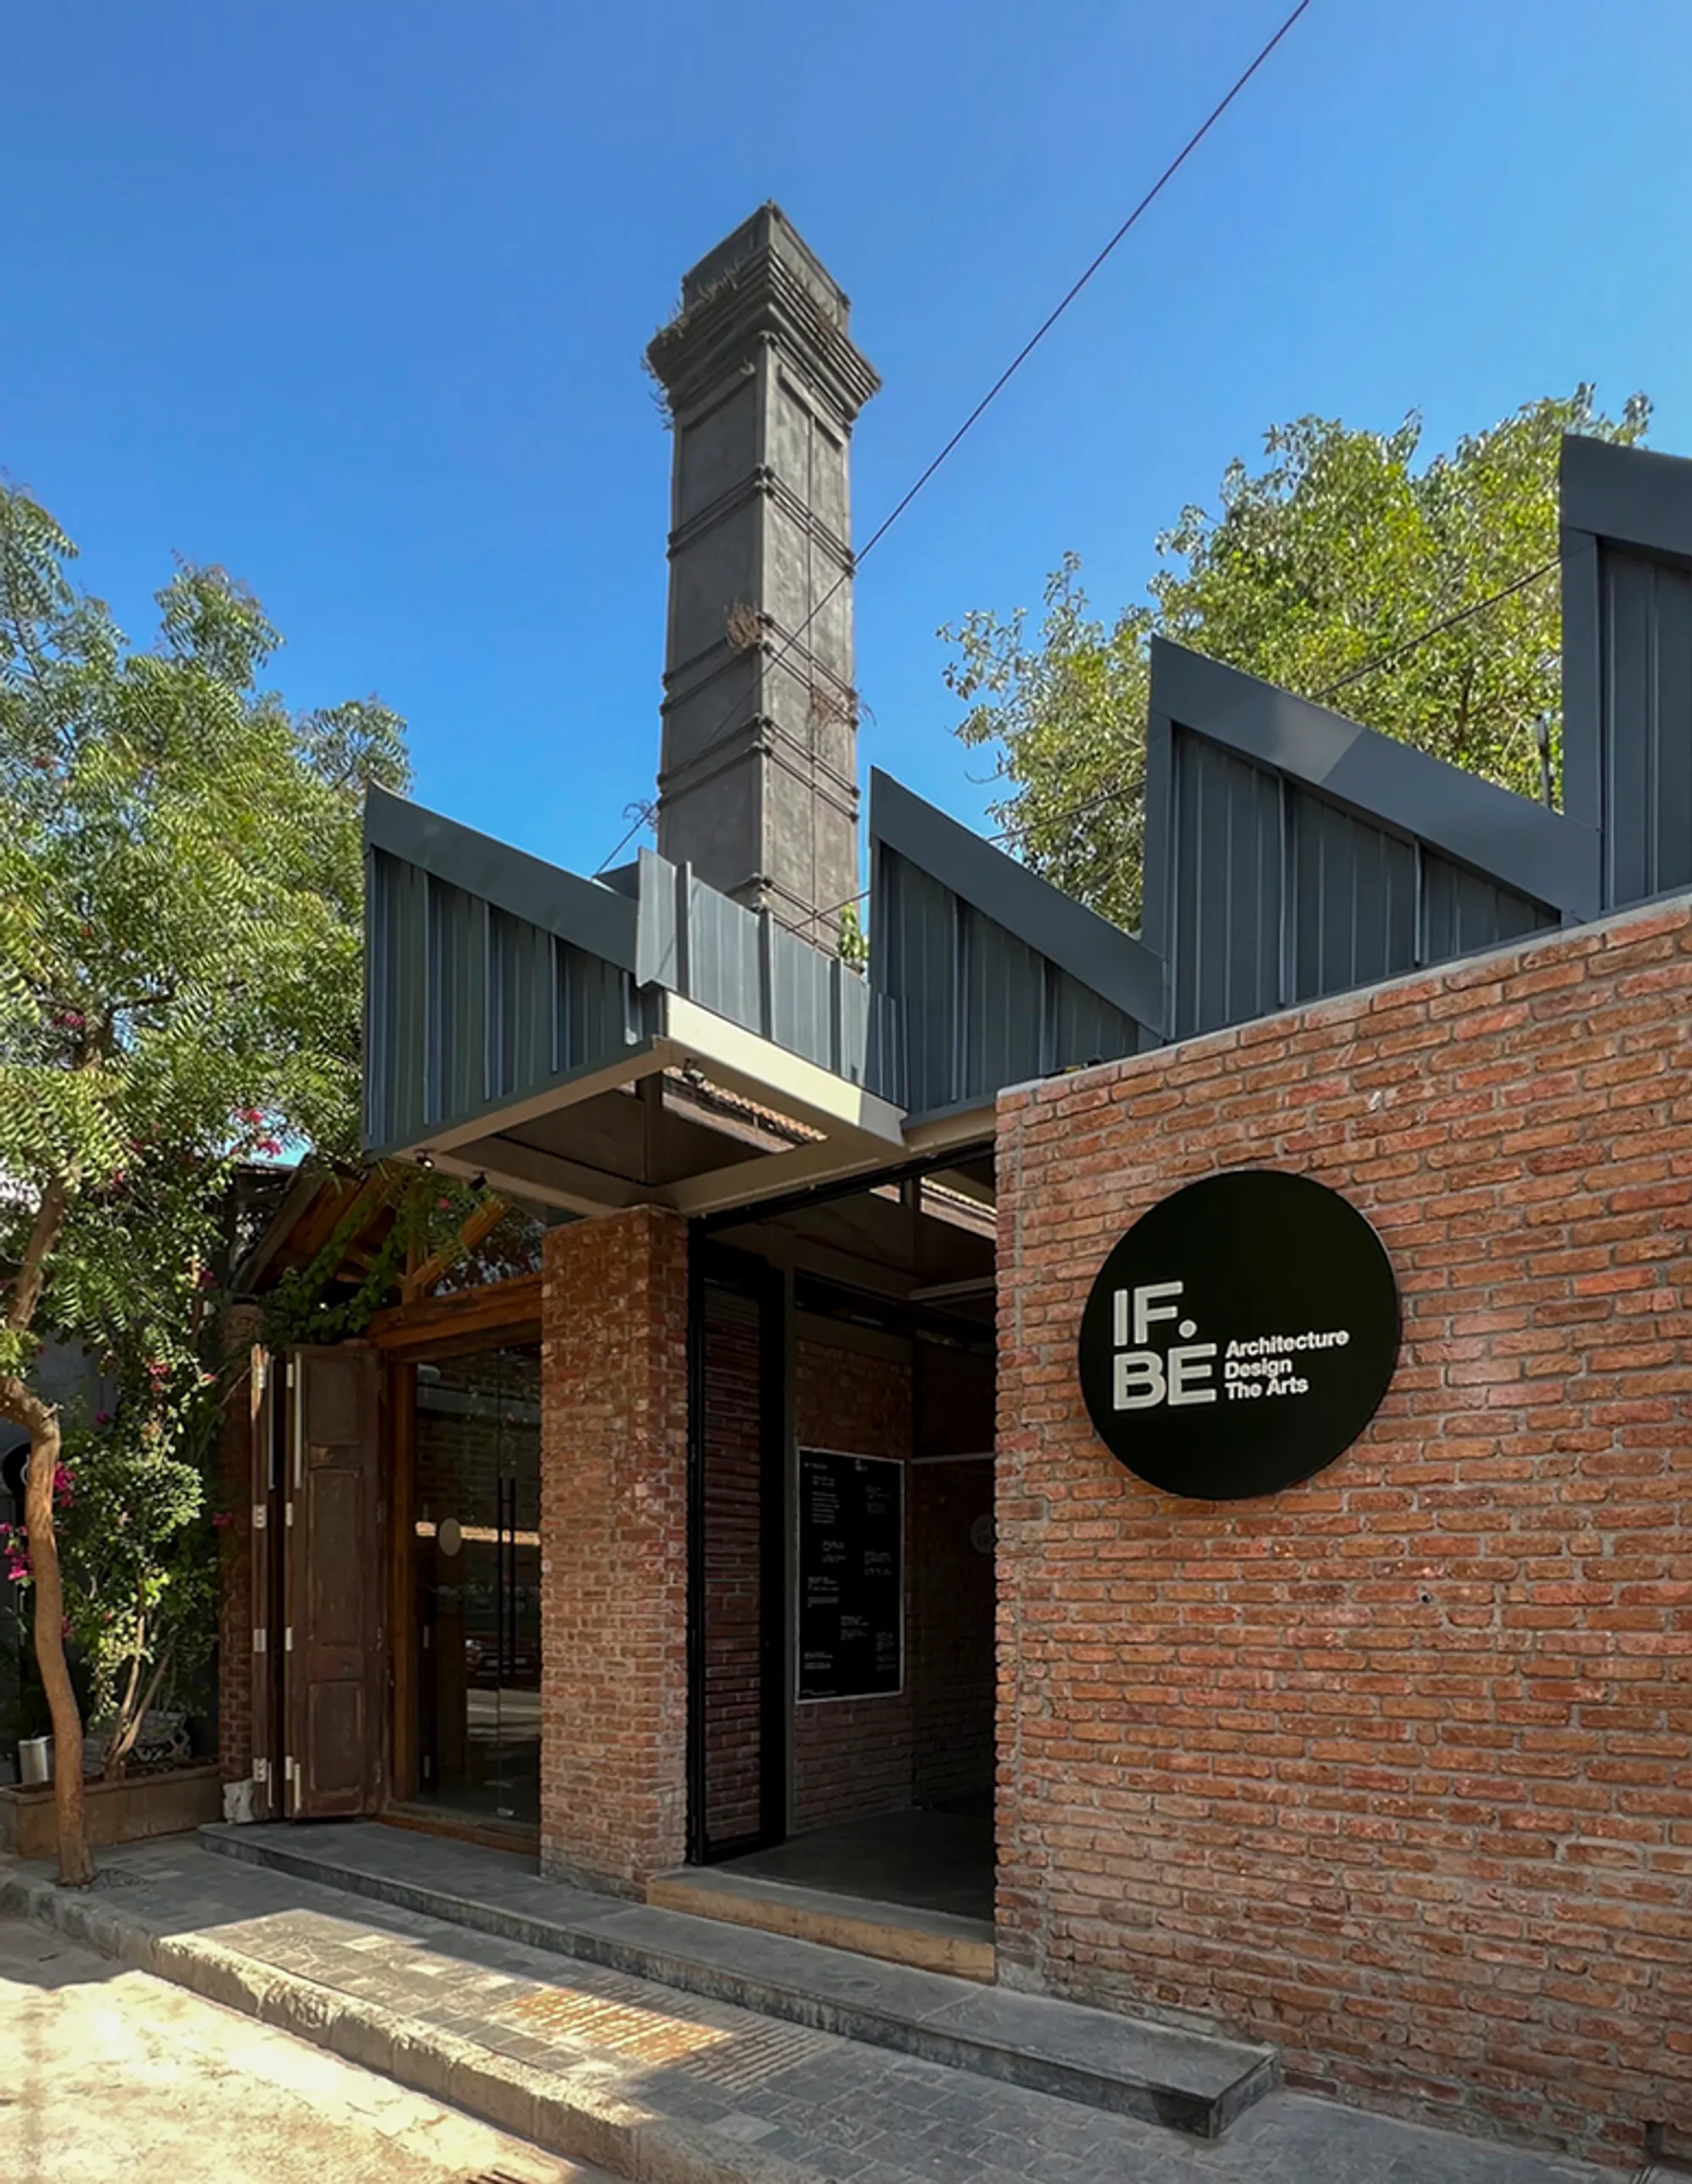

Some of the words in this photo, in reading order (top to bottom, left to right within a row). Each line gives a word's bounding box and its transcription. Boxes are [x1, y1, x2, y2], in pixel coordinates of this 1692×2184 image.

[1113, 1280, 1198, 1346] IF.
[1225, 1329, 1350, 1359] Architecture
[1113, 1343, 1217, 1411] BE
[1224, 1358, 1293, 1380] Design
[1224, 1381, 1262, 1400] The
[1266, 1377, 1309, 1396] Arts
